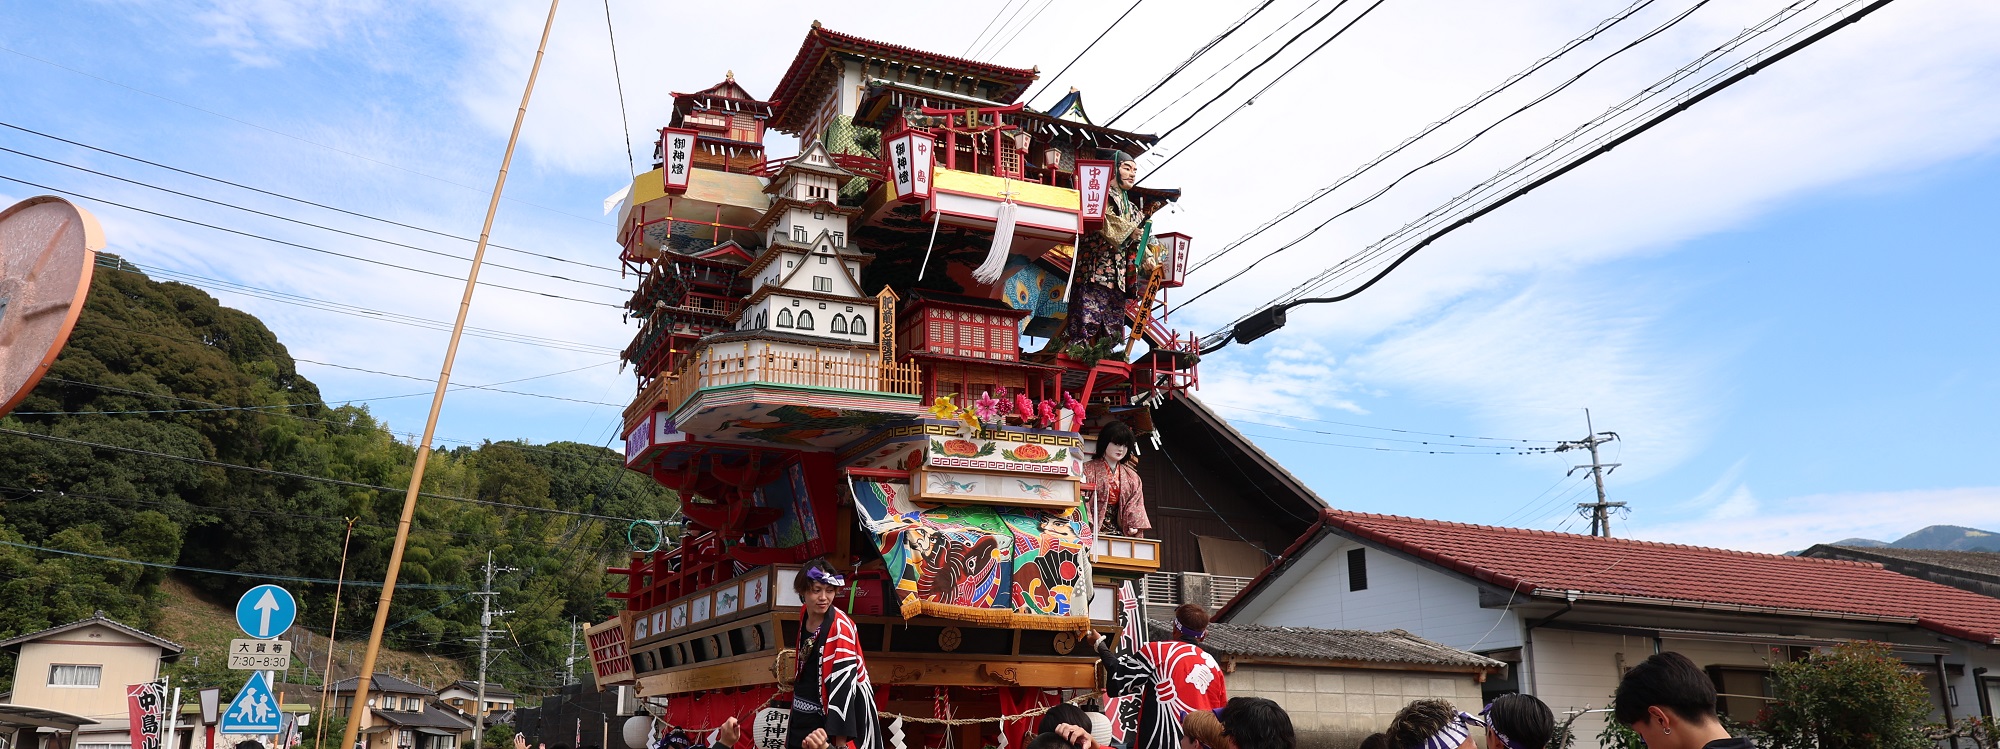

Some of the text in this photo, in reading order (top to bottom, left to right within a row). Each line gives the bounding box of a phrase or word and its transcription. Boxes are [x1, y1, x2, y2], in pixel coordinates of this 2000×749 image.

[671, 137, 686, 175] 御神燈
[895, 142, 909, 185] 御神燈
[917, 142, 927, 184] 中島
[1086, 166, 1101, 215] 中島山笠
[232, 656, 286, 667] 7:30-8:30
